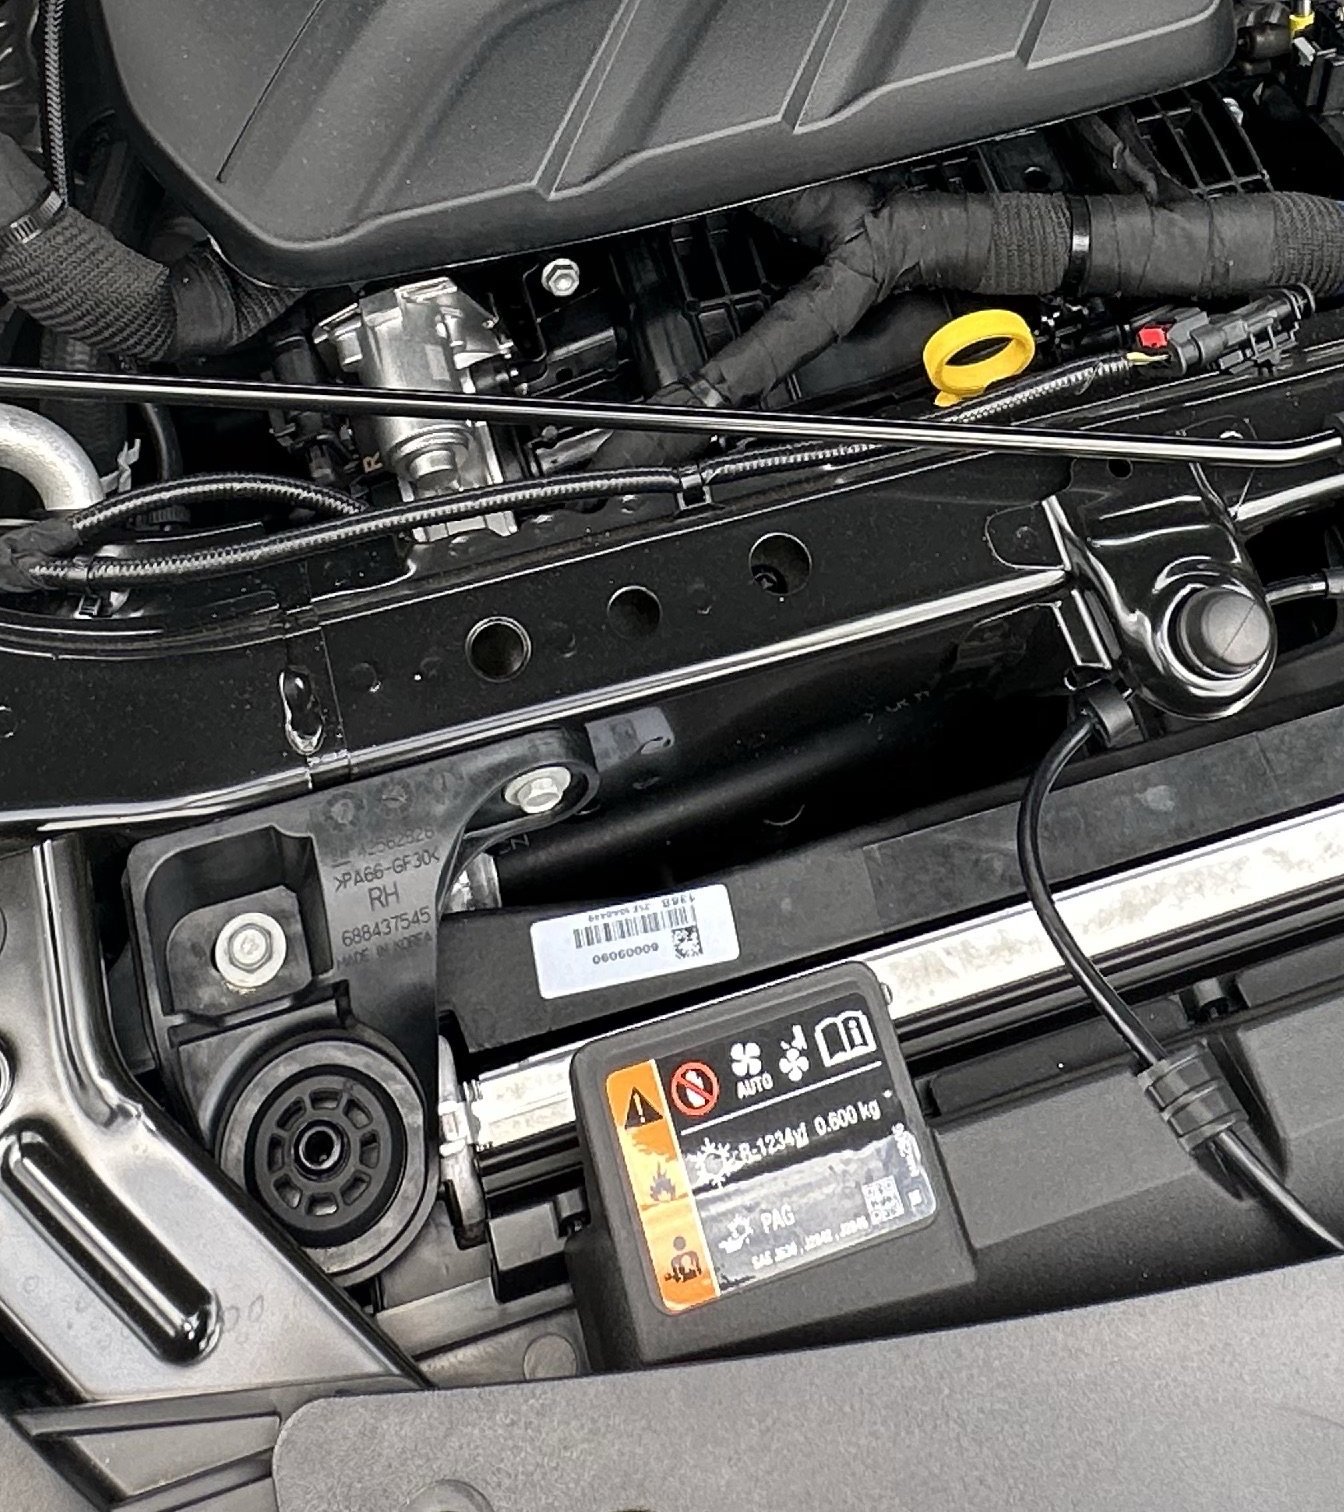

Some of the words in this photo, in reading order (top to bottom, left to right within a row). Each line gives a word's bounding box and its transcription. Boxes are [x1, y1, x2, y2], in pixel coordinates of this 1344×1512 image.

[368, 880, 401, 912] RH
[737, 1071, 774, 1100] AUTO
[813, 1104, 859, 1137] 0.600
[857, 1099, 882, 1121] kg
[760, 1203, 796, 1234] PAG
